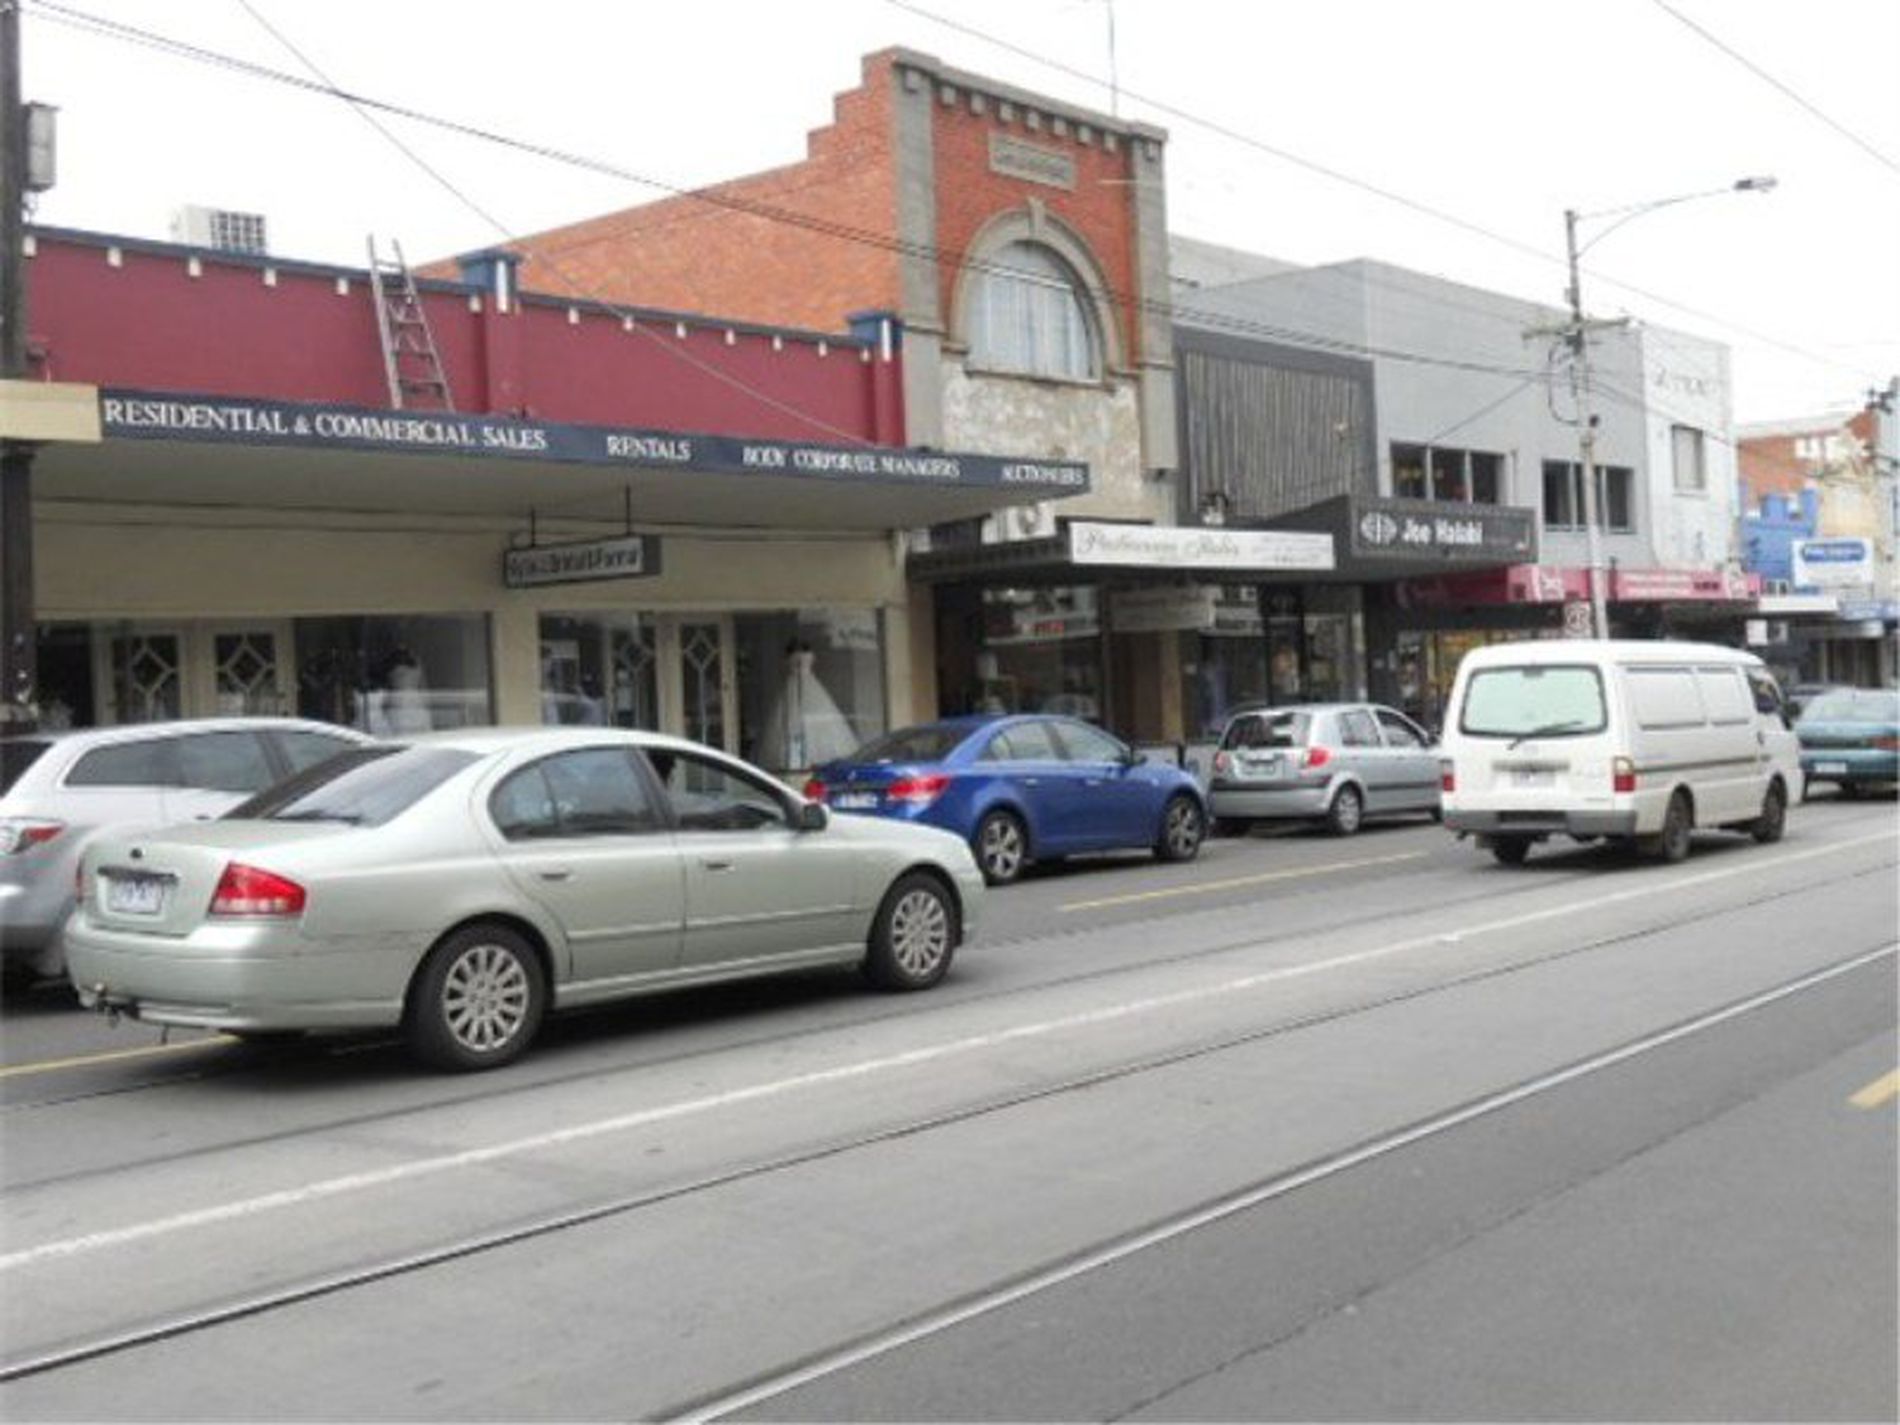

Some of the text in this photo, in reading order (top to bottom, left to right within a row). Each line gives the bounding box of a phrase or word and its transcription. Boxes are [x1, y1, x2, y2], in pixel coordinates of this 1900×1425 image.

[104, 399, 548, 450] RESIDENTIAL & COMMERCIAL SALES
[606, 435, 691, 462] RENTALS
[742, 446, 961, 478] BODY CORPORATE MANAGERS
